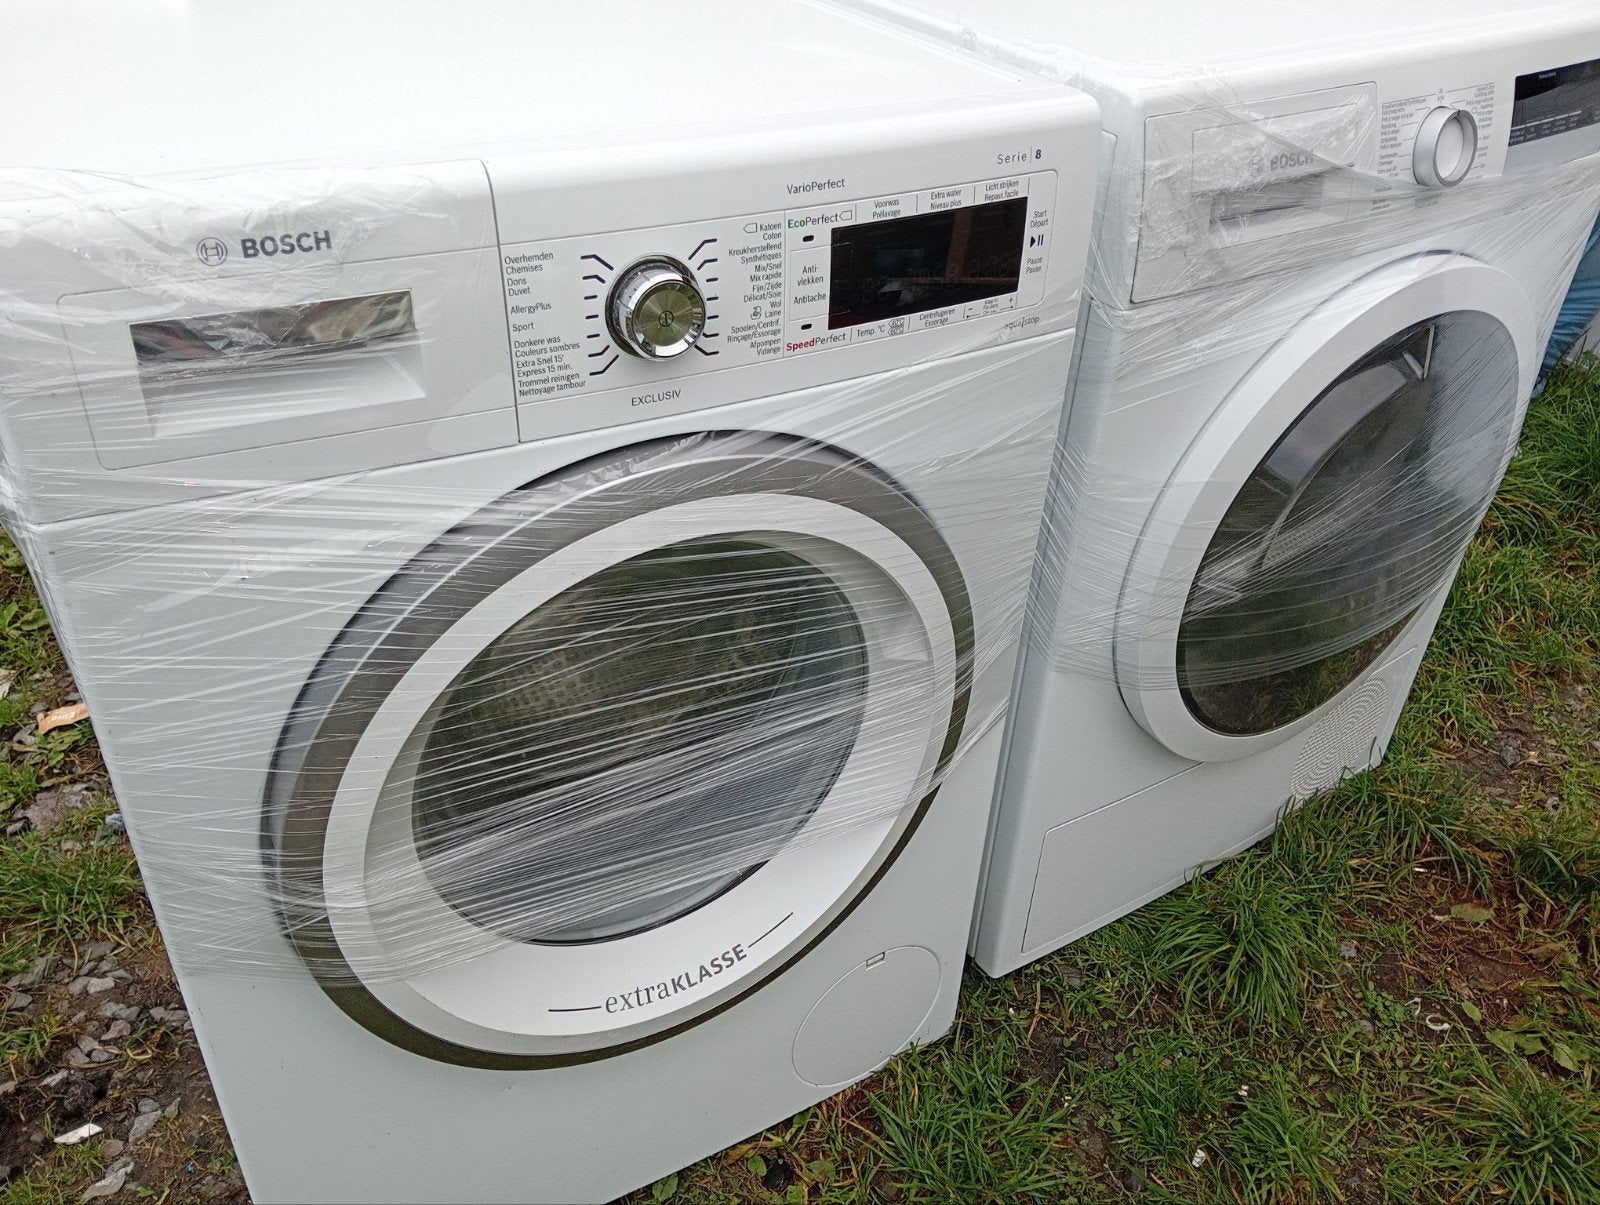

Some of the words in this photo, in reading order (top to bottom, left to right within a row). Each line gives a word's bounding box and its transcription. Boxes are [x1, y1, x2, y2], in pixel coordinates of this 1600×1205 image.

[997, 151, 1027, 165] Serie
[1035, 149, 1042, 160] 8
[786, 178, 846, 195] VarioPerfect
[930, 191, 945, 200] Extra
[946, 188, 962, 197] water
[874, 198, 900, 208] Voorwas
[930, 202, 949, 211] Niveau
[949, 199, 962, 208] plus
[872, 208, 901, 219] Prélavage
[1033, 209, 1047, 219] Start
[759, 222, 782, 231] Katoen
[787, 212, 839, 229] EcoPerfect
[1030, 217, 1049, 229] Départ
[762, 232, 782, 241] Coton
[240, 230, 332, 259] BOSCH
[728, 241, 782, 257] Kreukherstellend
[504, 252, 554, 265] Overhemden
[740, 252, 783, 265] Synthétiques
[505, 264, 544, 275] Chemises
[802, 264, 819, 275] Anti-
[1025, 265, 1042, 275] Pause
[507, 277, 528, 287] Dons
[749, 274, 761, 282] Mix
[761, 270, 783, 281] rapide
[797, 275, 824, 287] vlekken
[508, 286, 531, 297] Duvet
[769, 299, 782, 308] Wol
[793, 292, 827, 305] Antitache
[510, 301, 552, 315] AllergyPlus
[919, 308, 956, 321] Centrifugeren
[512, 322, 535, 334] Sport
[924, 317, 949, 328] Essorage
[856, 327, 877, 338] Temp.
[514, 338, 545, 349] Donkere
[546, 336, 561, 344] was
[750, 338, 782, 349] Afpompen
[786, 333, 847, 351] SpeedPerfect
[515, 346, 548, 358] Couleurs
[549, 342, 581, 353] sombres
[756, 346, 781, 356] Vidange
[516, 359, 536, 369] Extra
[536, 355, 553, 366] Snel
[517, 368, 546, 378] Express
[547, 364, 555, 373] 15
[557, 363, 573, 371] min.
[518, 376, 550, 388] Trommel
[550, 372, 580, 383] reinigen
[519, 385, 556, 397] Nettoyage
[556, 380, 587, 391] tambour
[631, 389, 681, 407] EXCLUSIV
[605, 943, 748, 1014] extraKLASSE
